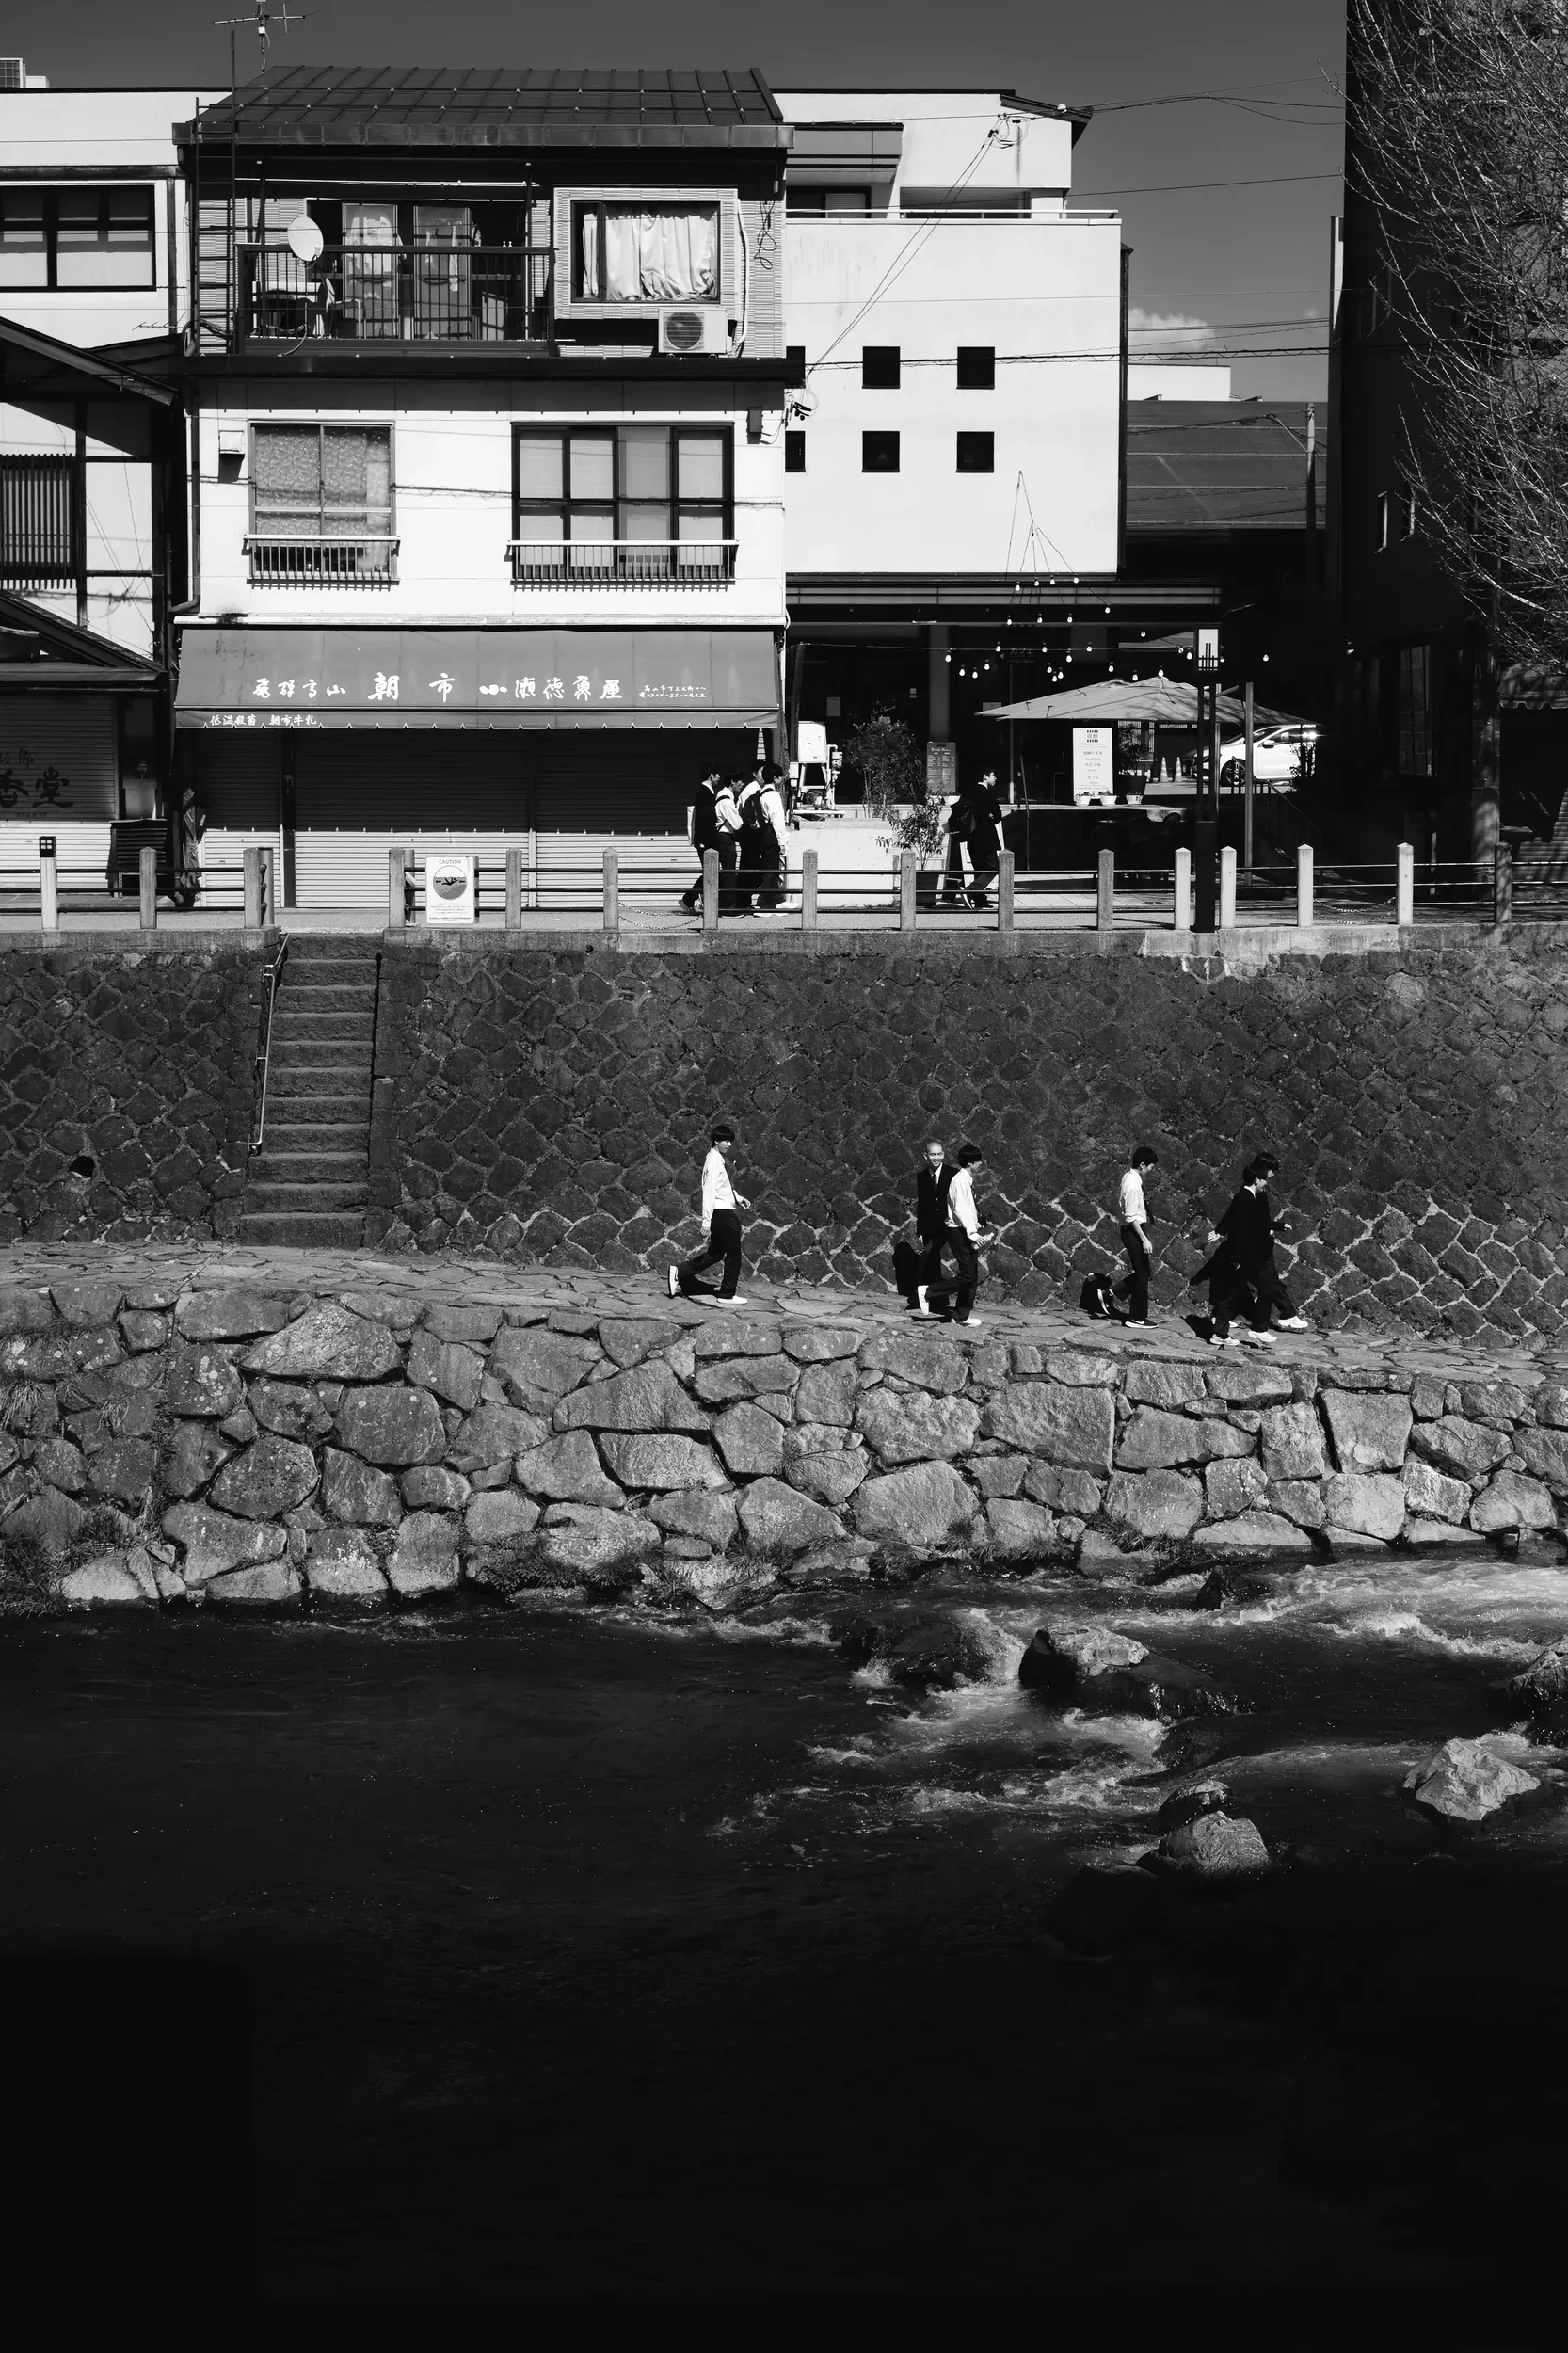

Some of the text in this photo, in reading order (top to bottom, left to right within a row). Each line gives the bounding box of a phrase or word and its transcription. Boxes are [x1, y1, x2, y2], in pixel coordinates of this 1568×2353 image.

[367, 671, 456, 703] 朝市
[210, 713, 317, 727] 低温殺菌 朝市牛乳
